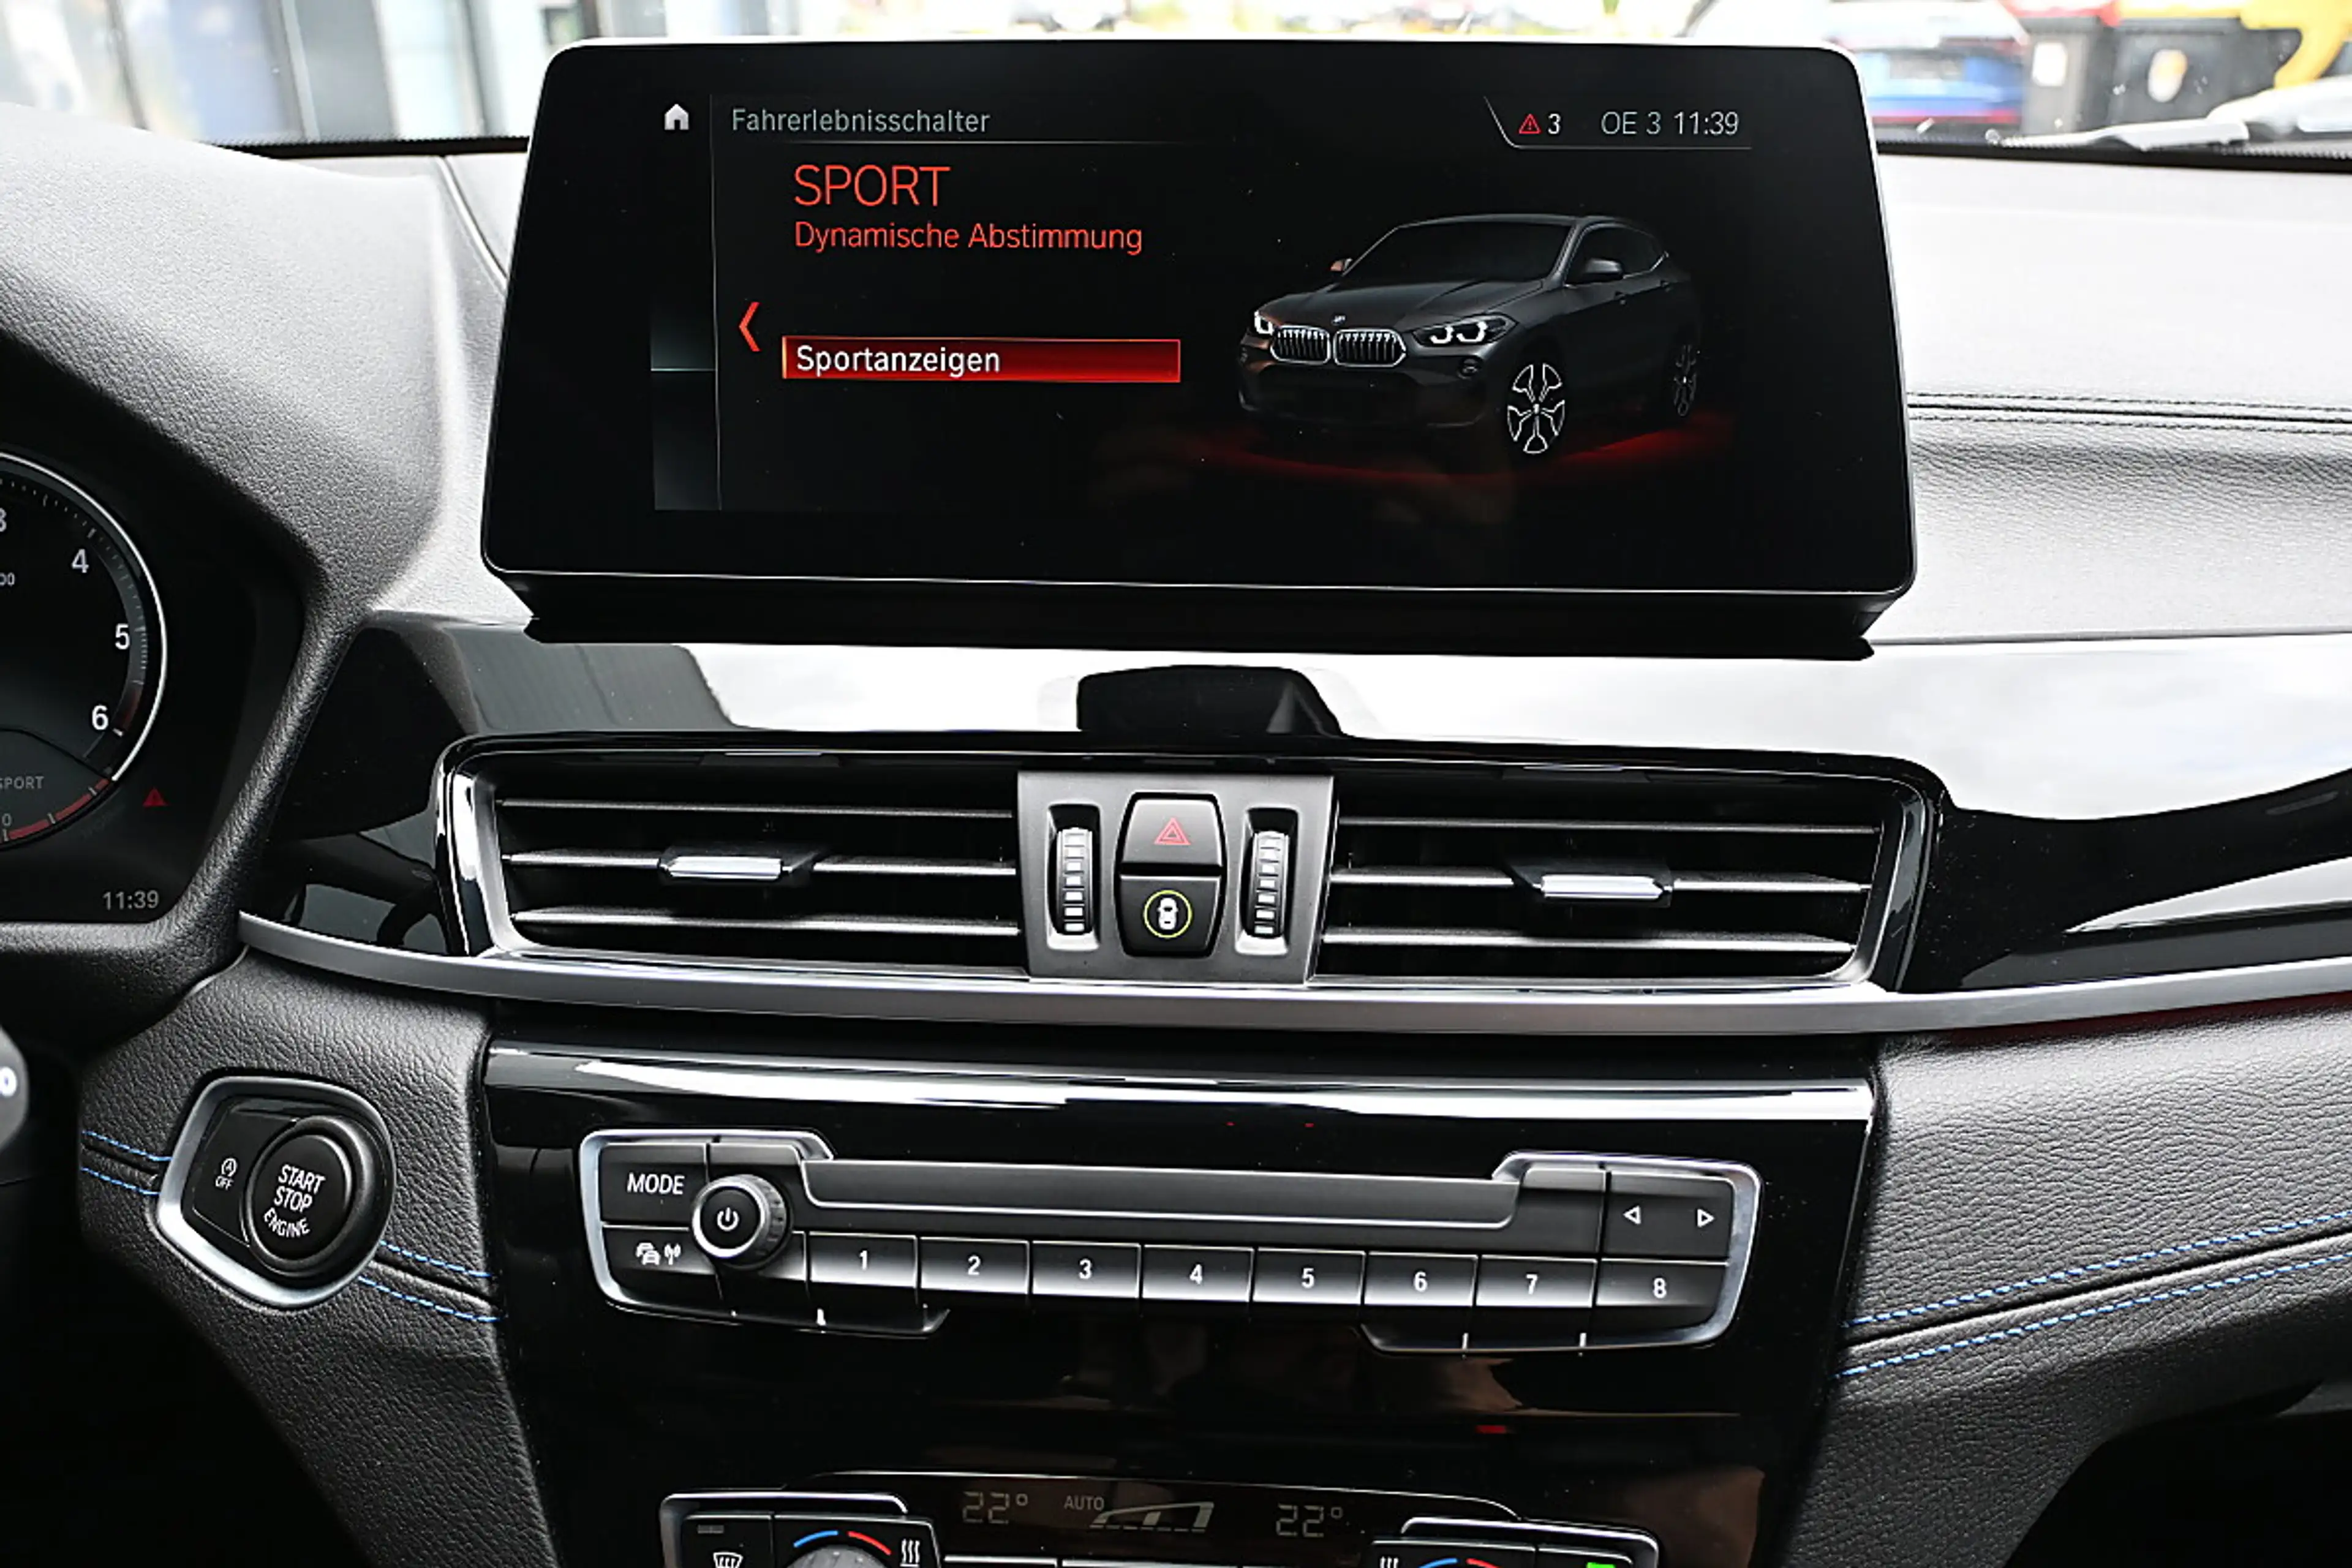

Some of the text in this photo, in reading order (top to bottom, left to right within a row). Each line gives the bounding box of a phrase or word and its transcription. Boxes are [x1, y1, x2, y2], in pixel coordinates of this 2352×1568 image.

[732, 108, 990, 133] Fahrerlebnisschalter
[1547, 113, 1561, 135] 3
[1600, 111, 1740, 135] OE 3 11:39
[794, 164, 951, 206] SPORT
[795, 221, 1142, 256] Dynamische Abstimmung
[797, 345, 1000, 379] Sportanzeigen
[71, 549, 89, 573] 4
[115, 624, 130, 650] 5
[91, 704, 109, 730] 6
[103, 890, 159, 910] 11:39
[215, 1175, 235, 1190] OFF
[277, 1164, 326, 1194] START
[626, 1172, 686, 1196] MODE
[274, 1185, 313, 1213] STOP
[263, 1207, 311, 1238] ENGINE
[859, 1250, 868, 1270] 1
[968, 1255, 981, 1276] 2
[1079, 1259, 1092, 1280] 3
[1189, 1264, 1203, 1284] 4
[1302, 1267, 1315, 1289] 5
[1413, 1271, 1428, 1292] 6
[1526, 1273, 1538, 1295] 7
[1653, 1277, 1667, 1298] 8
[962, 1491, 1028, 1524] 22°
[1064, 1495, 1104, 1511] AUTO
